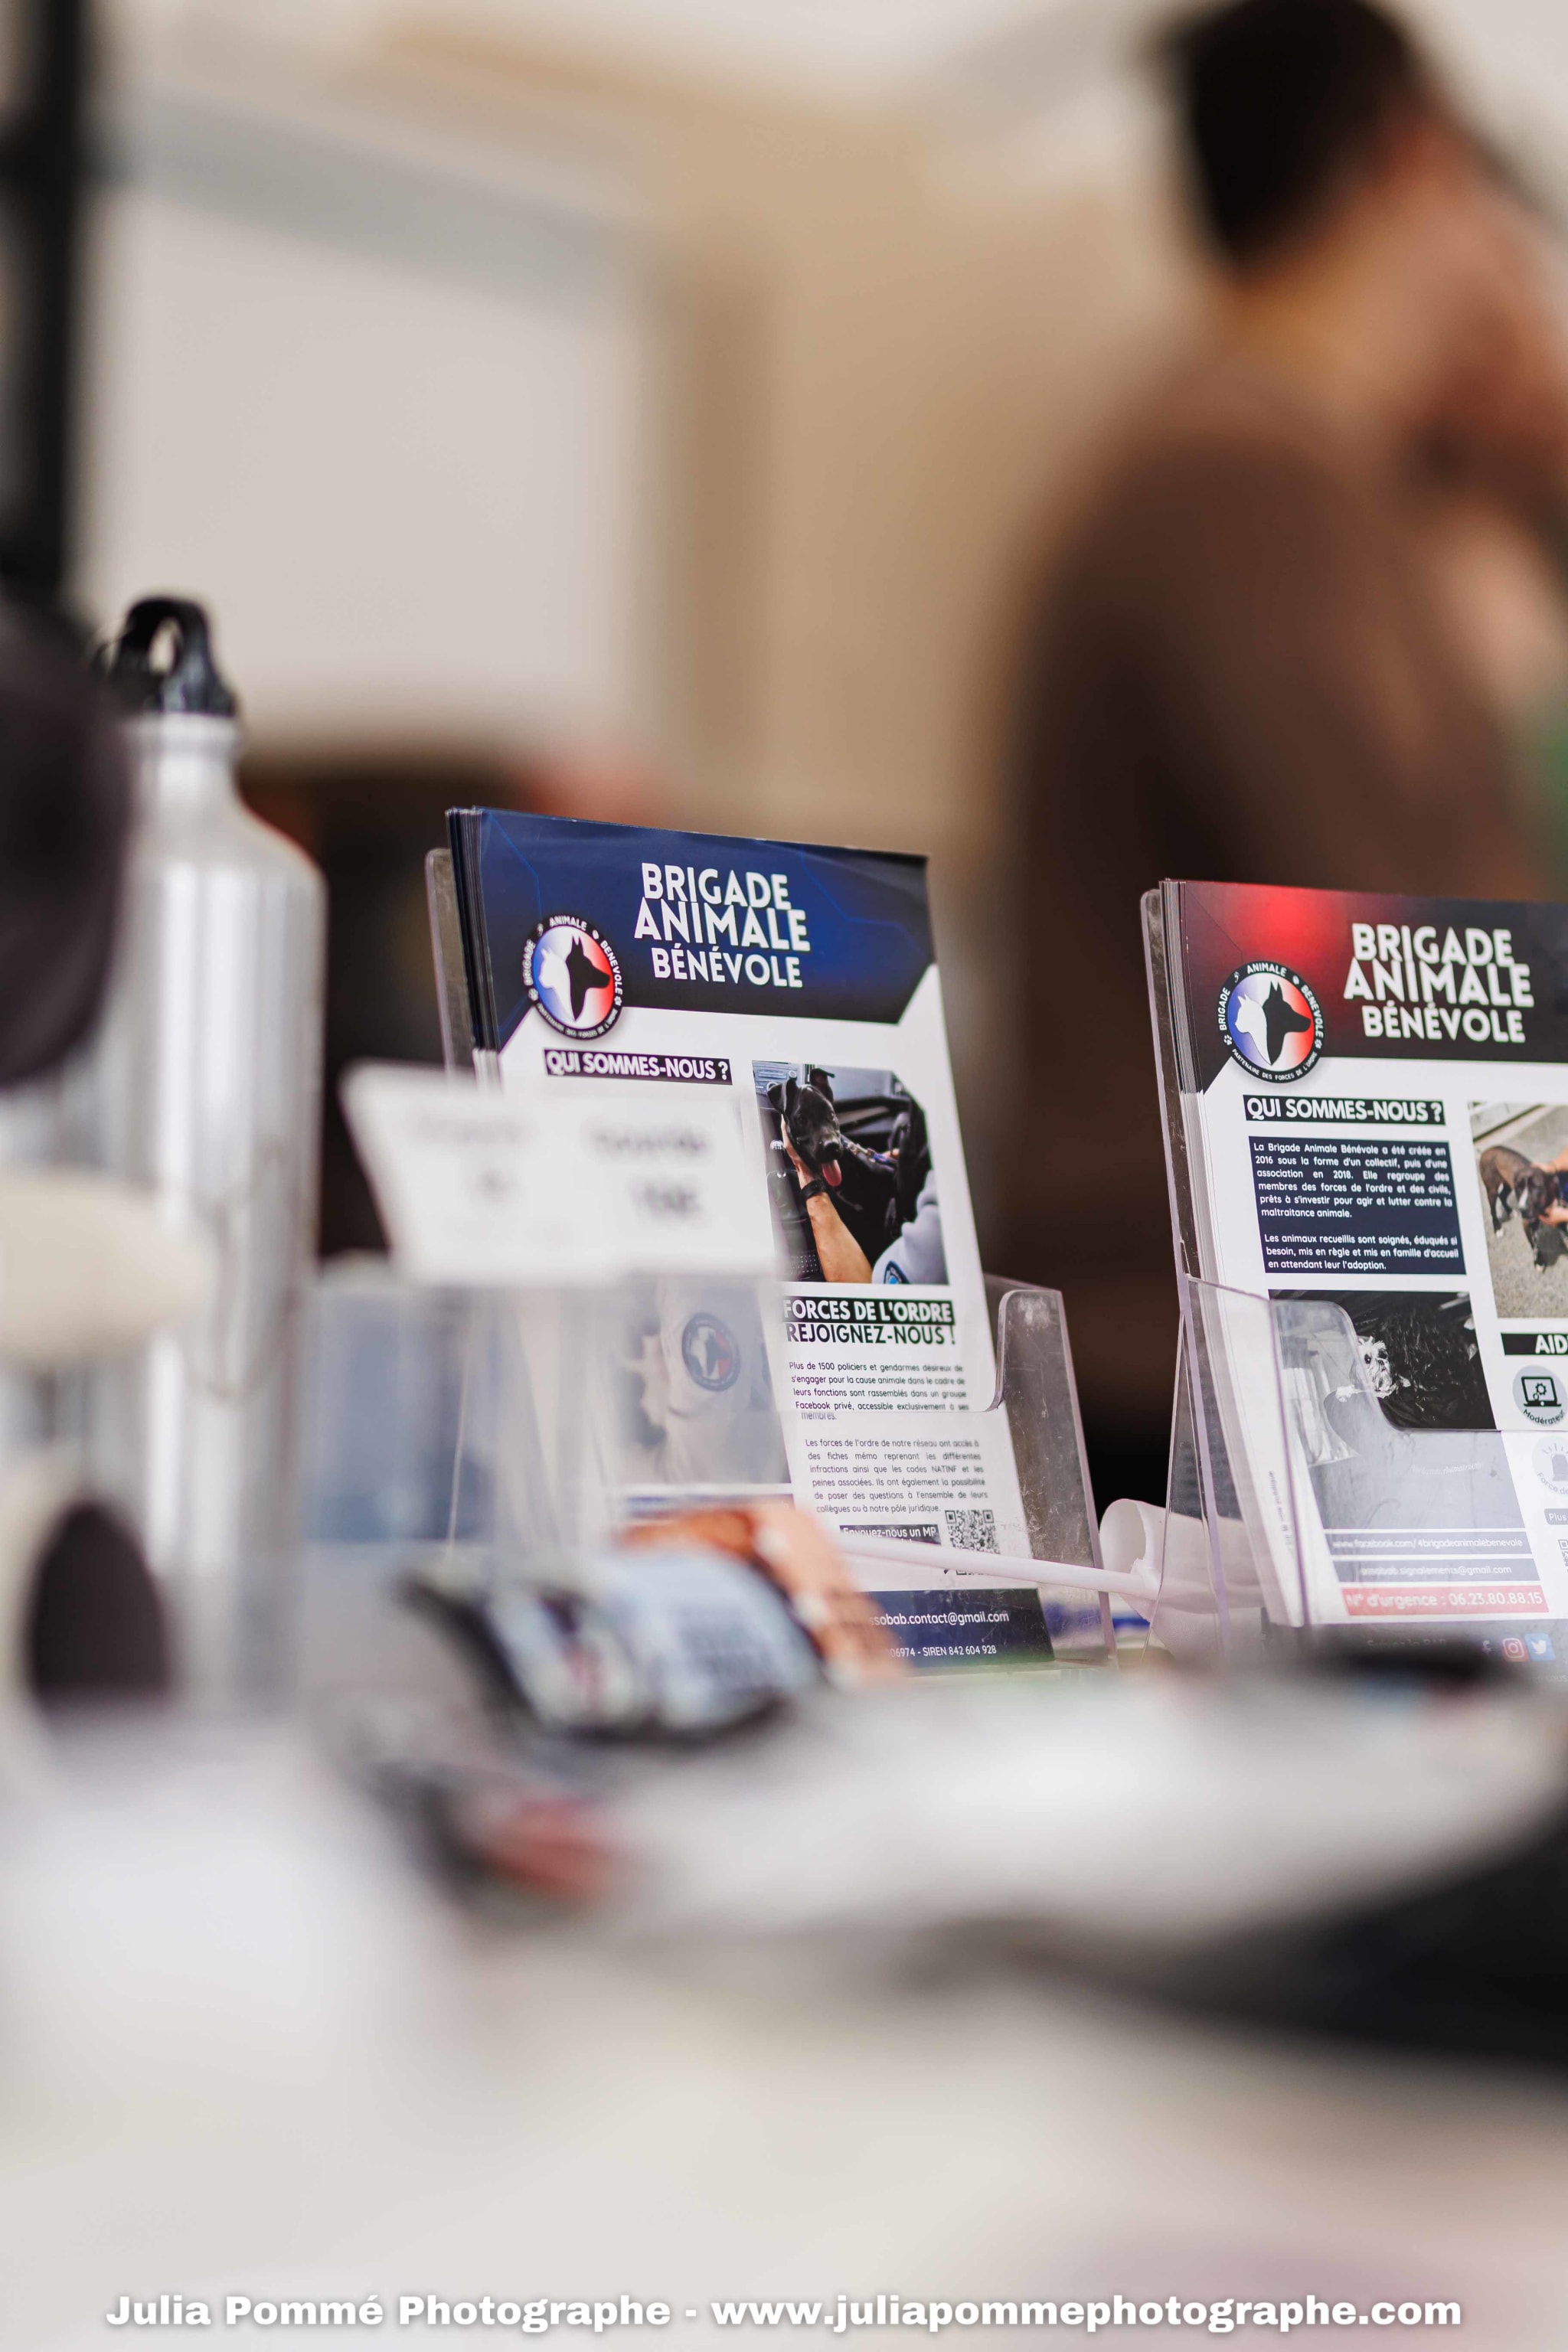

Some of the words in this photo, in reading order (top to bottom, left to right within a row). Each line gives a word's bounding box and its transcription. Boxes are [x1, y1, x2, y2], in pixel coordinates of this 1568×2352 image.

[641, 862, 791, 910] BRIGADE
[549, 915, 587, 931] ANIMALE
[634, 897, 811, 951] ANIMALE
[1351, 923, 1514, 967] BRIGADE
[651, 945, 802, 988] BÉNÉVOLE
[1343, 957, 1534, 1008] ANIMALE
[1218, 987, 1230, 1031] BRIGADE
[1247, 962, 1286, 977] ANIMALE
[1362, 1001, 1525, 1043] BÉNÉVOLE
[547, 1050, 580, 1075] QUI
[583, 1054, 716, 1080] SOMMES-NOUS
[718, 1062, 727, 1080] ?
[1233, 1049, 1259, 1075] PARTENAIRE
[1246, 1098, 1282, 1121] QUI
[1285, 1099, 1426, 1121] SOMMES-NOUS
[1430, 1102, 1442, 1122] ?
[1268, 1143, 1300, 1153] Brigade
[1304, 1145, 1337, 1153] Animale
[1341, 1145, 1378, 1154] Bénévole
[1392, 1145, 1405, 1155] été
[1314, 1157, 1338, 1166] forme
[1344, 1158, 1361, 1166] d'un
[1365, 1158, 1400, 1168] collectif,
[1404, 1158, 1421, 1169] puis
[1426, 1159, 1447, 1168] d'une
[1257, 1169, 1303, 1178] association
[1333, 1171, 1354, 1179] 2018.
[1387, 1173, 1425, 1182] regroupe
[1435, 1172, 1449, 1181] des
[1259, 1182, 1297, 1191] membres
[1321, 1183, 1347, 1191] forces
[1351, 1184, 1361, 1192] de
[1366, 1184, 1393, 1193] l'ordre
[1410, 1185, 1424, 1194] des
[1429, 1186, 1451, 1195] civils,
[1260, 1195, 1282, 1204] prêts
[1295, 1196, 1330, 1204] s'investir
[1357, 1197, 1373, 1207] agir
[1388, 1197, 1411, 1206] lutter
[1414, 1197, 1441, 1206] contre
[1445, 1198, 1452, 1207] la
[1262, 1208, 1315, 1217] maltraitance
[1320, 1235, 1355, 1243] recueillis
[1379, 1235, 1412, 1246] soignés,
[1414, 1236, 1448, 1246] éduqués
[1266, 1247, 1296, 1256] besoin,
[1328, 1248, 1350, 1257] règle
[1393, 1248, 1421, 1257] famille
[1424, 1249, 1459, 1258] d'accueil
[1325, 1261, 1341, 1269] leur
[1343, 1261, 1387, 1271] l'adoption.
[784, 1300, 851, 1320] FORCES
[854, 1302, 876, 1320] DE
[880, 1302, 952, 1321] L'ORDRE
[950, 1327, 955, 1344] !
[1535, 1334, 1568, 1354] AID
[838, 1363, 867, 1372] policiers
[880, 1364, 920, 1373] gendarmes
[792, 1376, 826, 1384] s'engager
[835, 1402, 854, 1410] privé,
[884, 1453, 920, 1462] reprenant
[812, 1478, 835, 1488] peines
[902, 1478, 939, 1488] également
[828, 1492, 848, 1501] poser
[870, 1491, 903, 1501] questions
[923, 1527, 936, 1537] MP
[1369, 1593, 1437, 1609] d'urgence
[870, 1612, 1009, 1625] ssobab.contact@gmail.com
[888, 1648, 915, 1658] 06974
[923, 1648, 946, 1656] SIREN
[949, 1646, 964, 1655] 842
[965, 1646, 980, 1655] 604
[982, 1645, 996, 1654] 928
